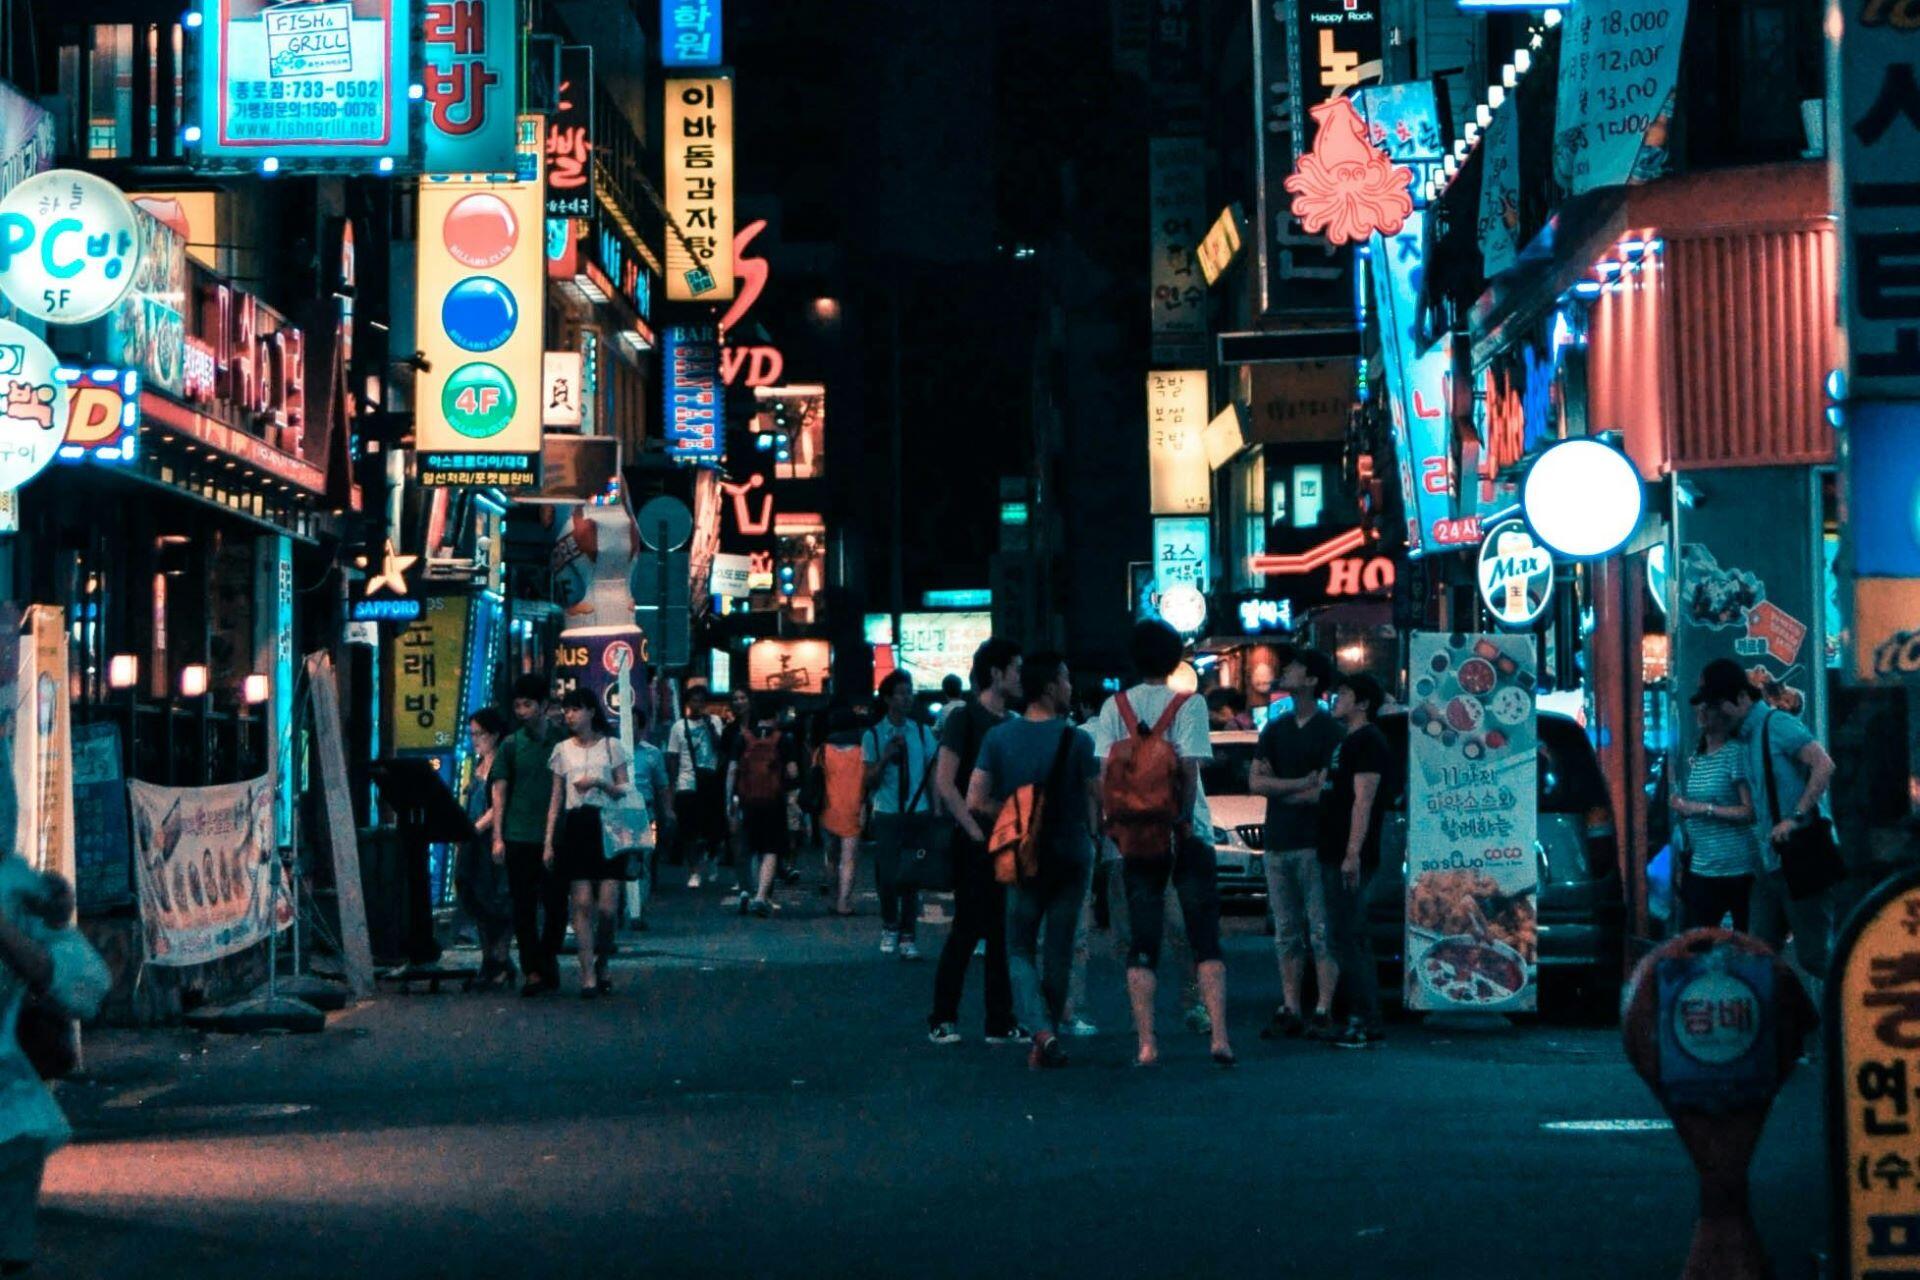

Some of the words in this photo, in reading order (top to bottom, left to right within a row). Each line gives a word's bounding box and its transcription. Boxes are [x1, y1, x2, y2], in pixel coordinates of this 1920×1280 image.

[1311, 12, 1343, 23] Happy
[1348, 11, 1374, 21] Rock
[1601, 10, 1668, 36] 18,000
[288, 35, 346, 52] GRILL
[235, 121, 377, 138] www.fishngrill.net
[43, 289, 71, 313] 5F
[674, 327, 713, 341] BAR
[455, 387, 501, 414] 4F
[1160, 543, 1198, 561] 죠스
[1488, 556, 1539, 589] Max
[355, 601, 420, 616] SAPPORO
